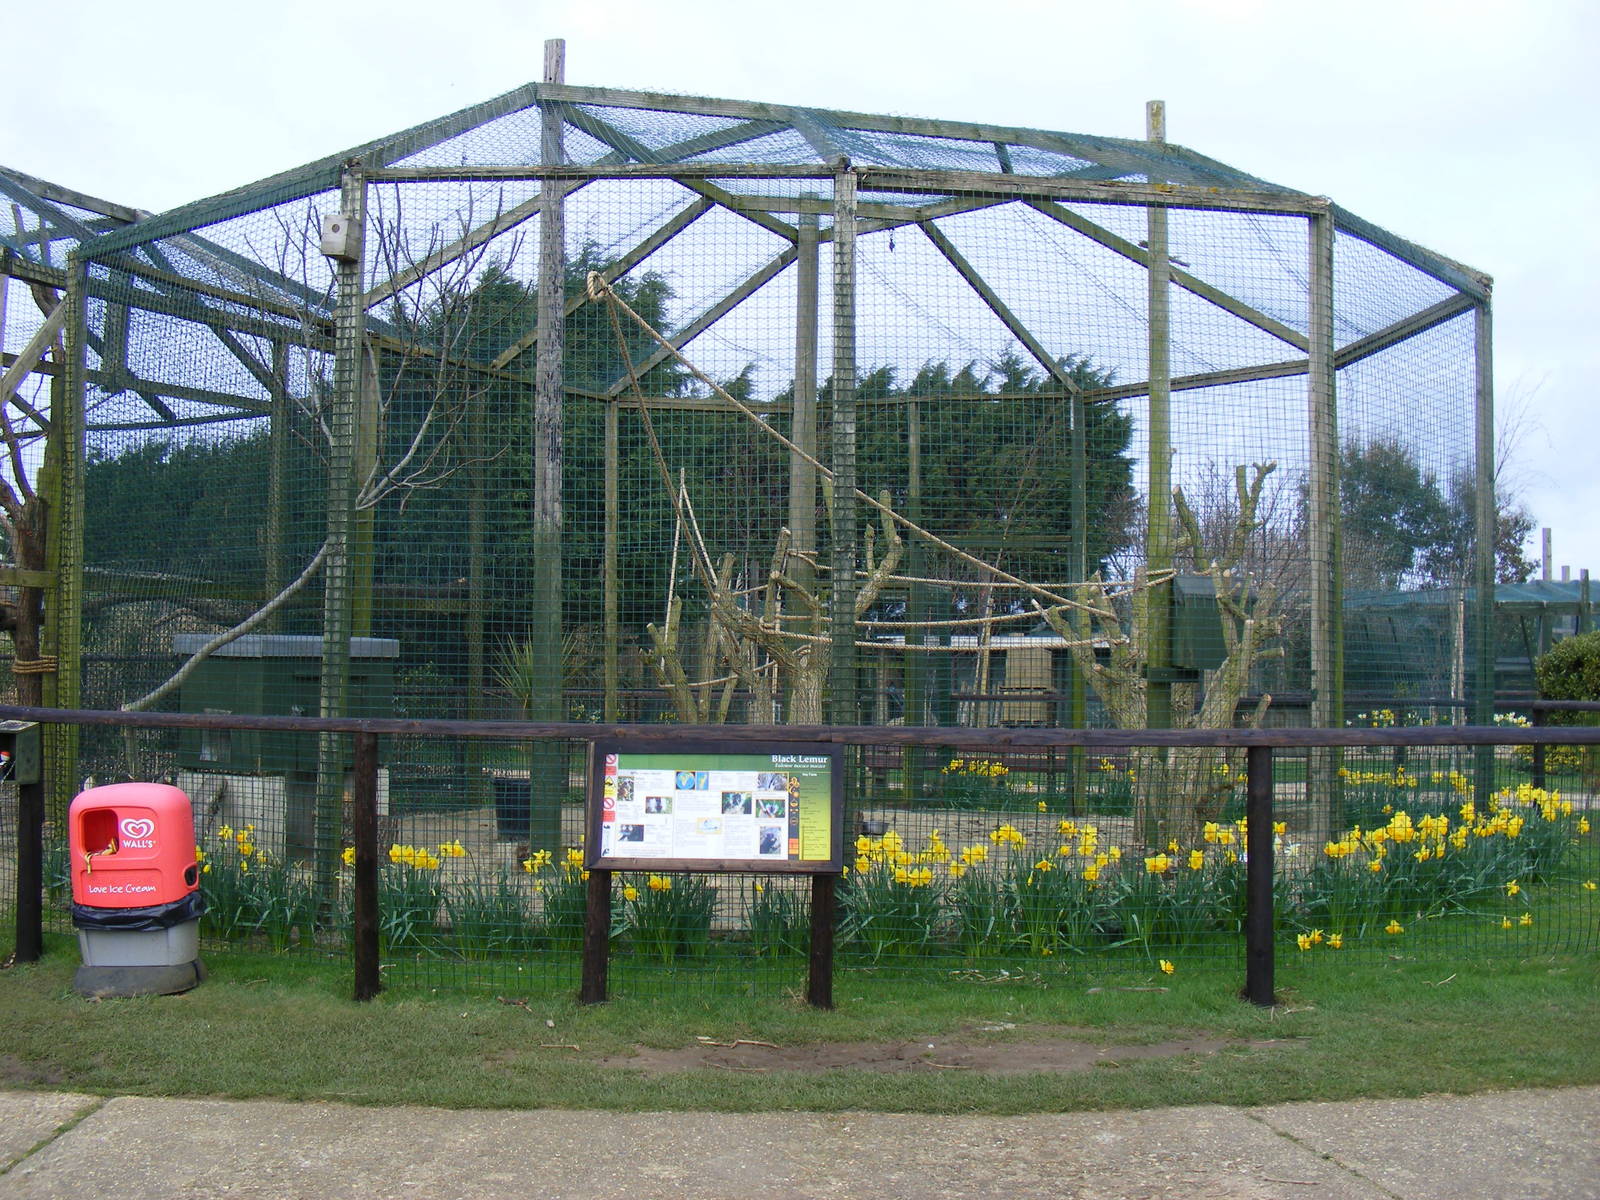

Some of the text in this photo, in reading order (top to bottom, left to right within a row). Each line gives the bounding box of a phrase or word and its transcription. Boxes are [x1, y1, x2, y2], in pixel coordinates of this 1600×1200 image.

[772, 754, 828, 763] Black Lemur
[122, 839, 153, 848] WALL'S
[89, 883, 156, 893] Love Ice Cream
